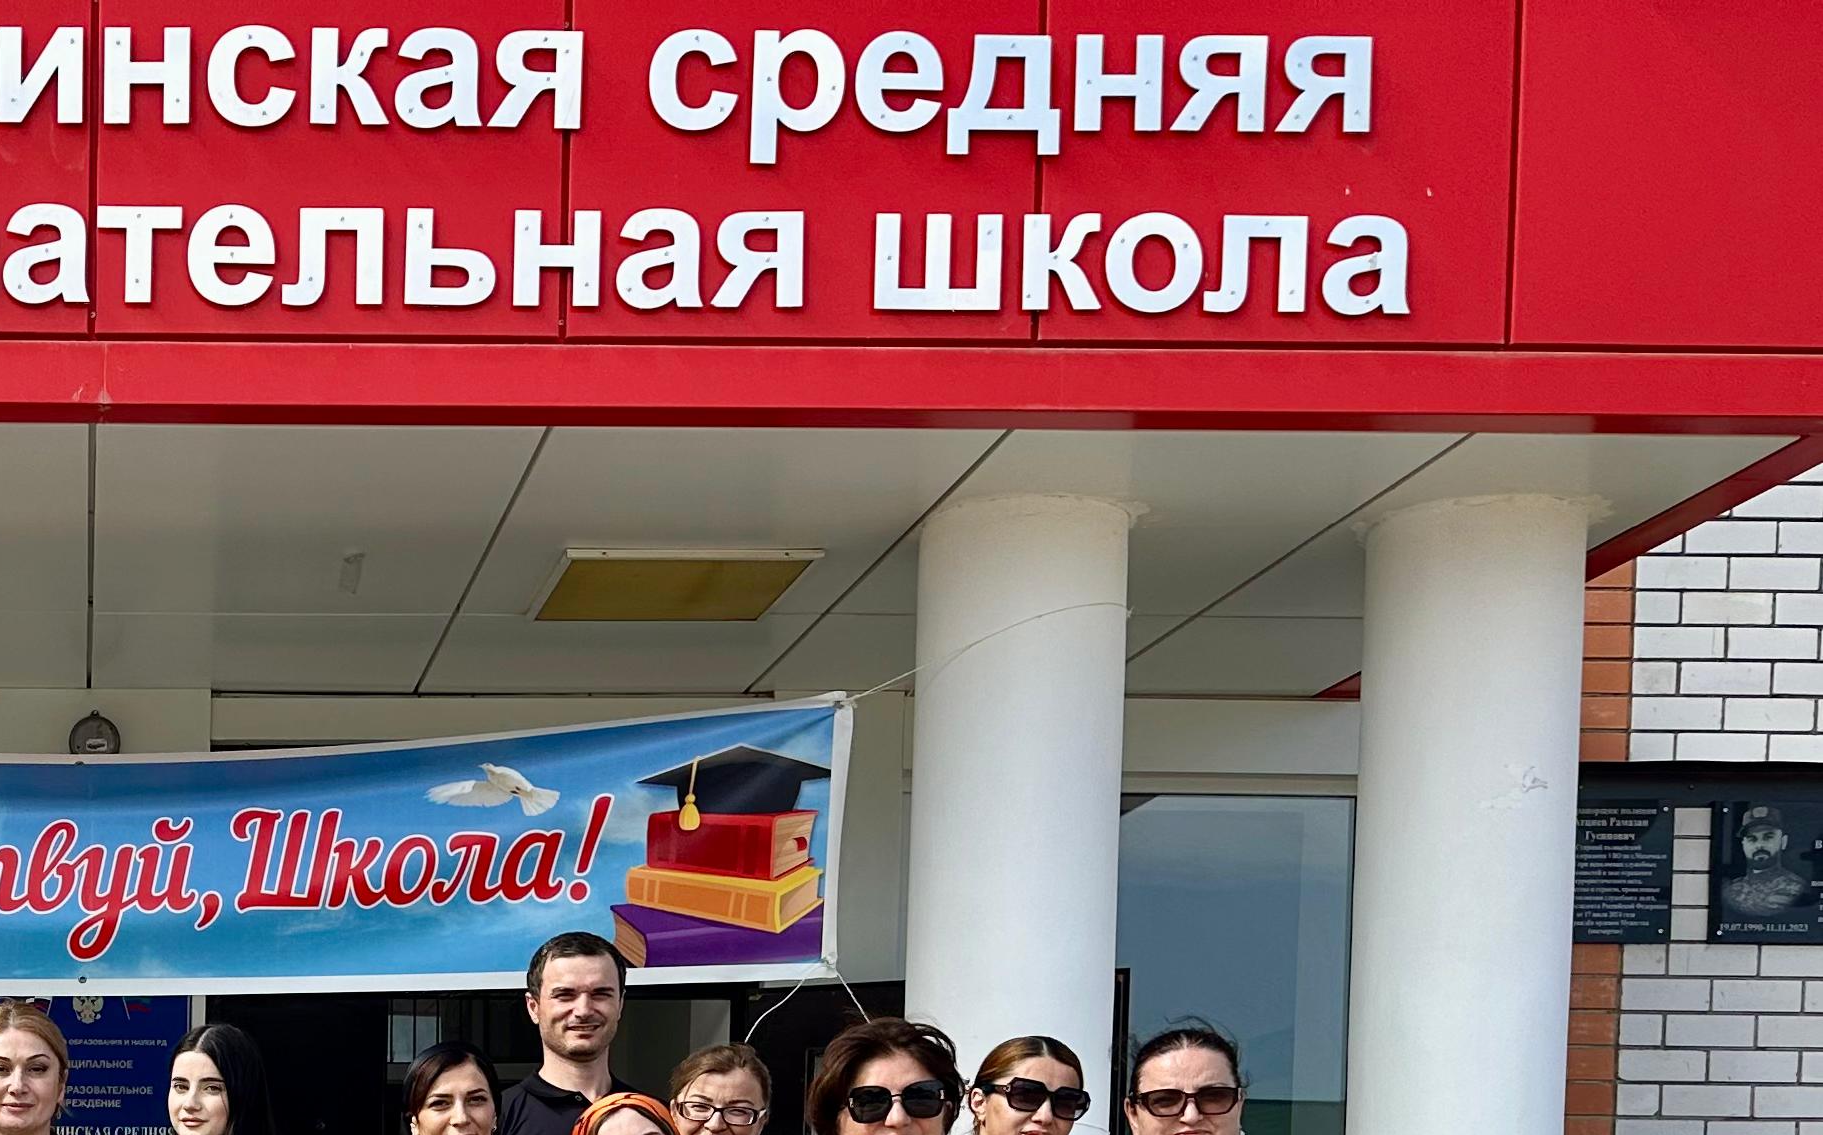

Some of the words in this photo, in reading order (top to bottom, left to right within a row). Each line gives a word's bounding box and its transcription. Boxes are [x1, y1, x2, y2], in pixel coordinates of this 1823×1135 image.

[649, 29, 1372, 164] средняя
[874, 213, 1409, 317] школа
[233, 795, 610, 910] Школа!
[68, 1038, 123, 1047] ОБРАЗОВАНИЯ
[131, 1039, 156, 1047] НАУКИ
[65, 1098, 121, 1109] РЕЖДЕНИЕ
[66, 1085, 153, 1096] РАЗОВАТЕЛЬНОЕ
